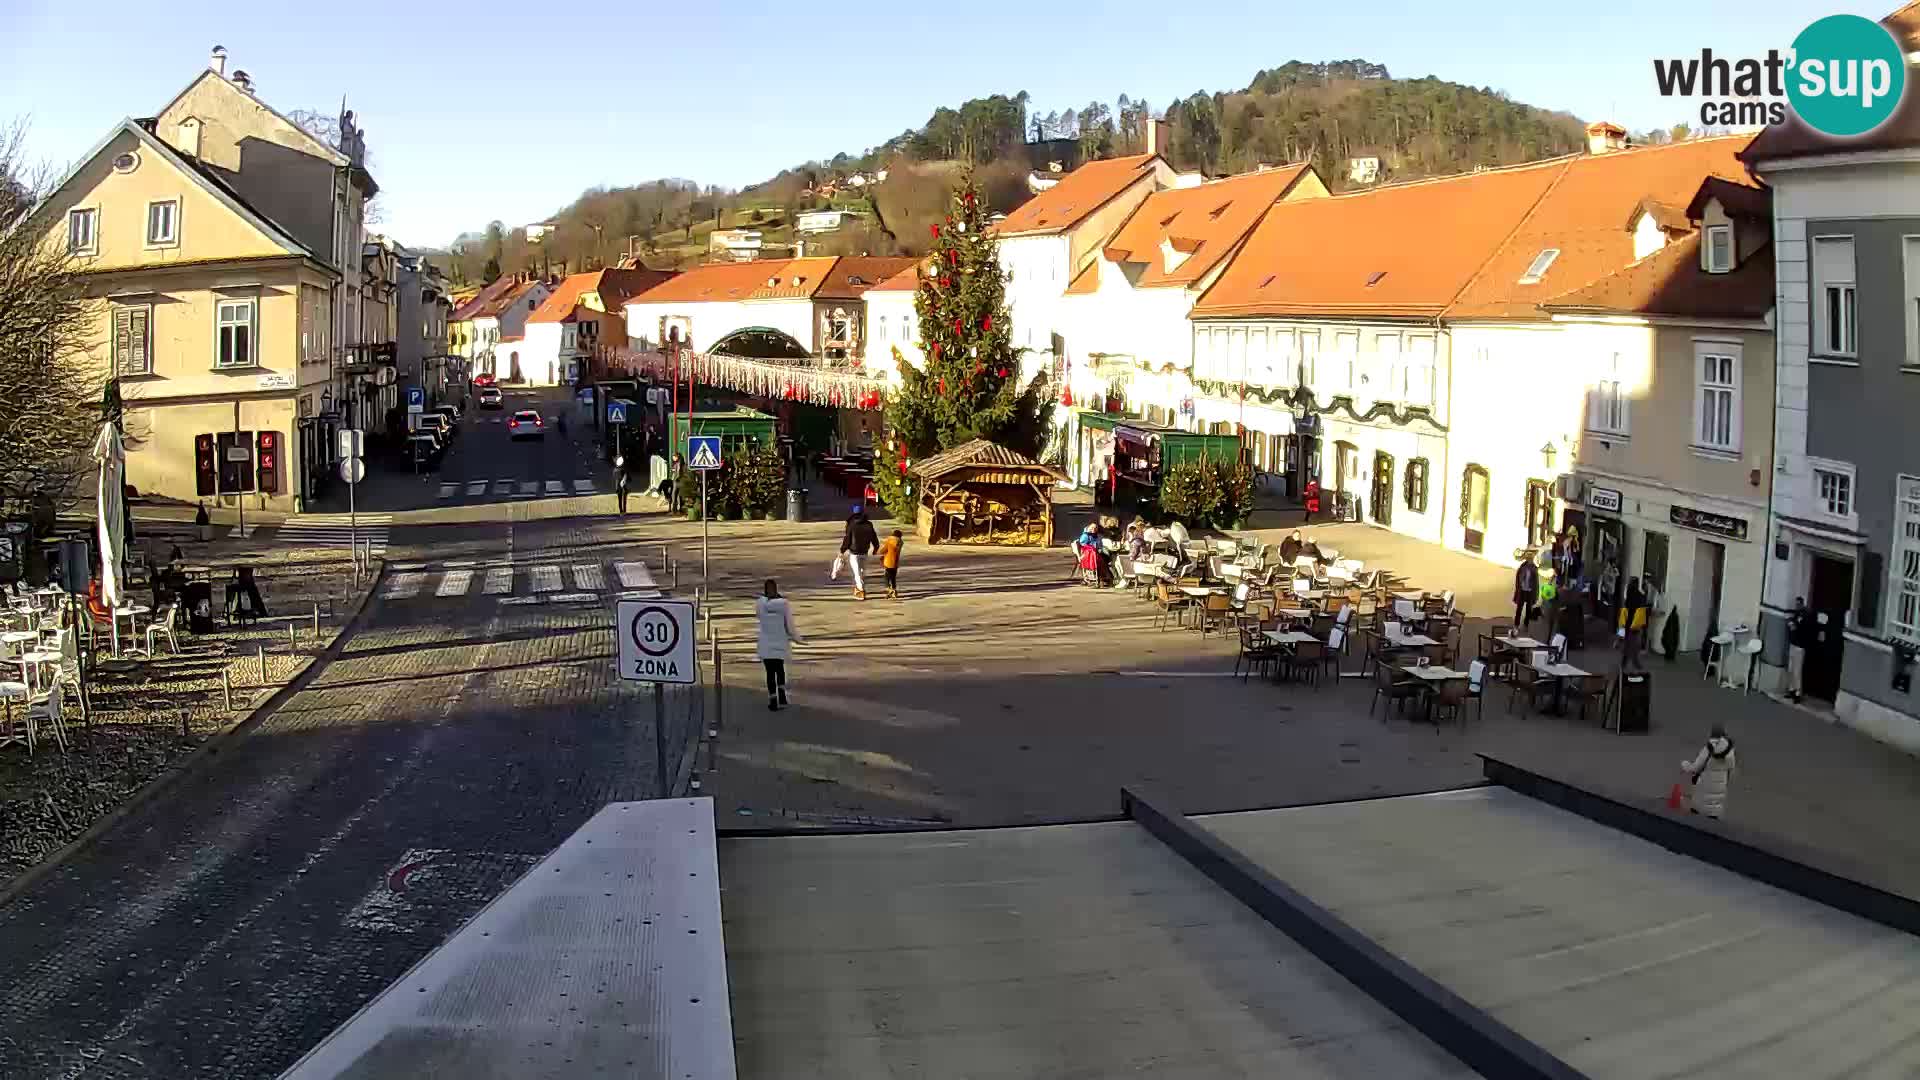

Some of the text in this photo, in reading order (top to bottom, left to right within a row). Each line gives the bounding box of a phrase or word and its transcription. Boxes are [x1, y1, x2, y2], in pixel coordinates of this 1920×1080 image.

[411, 391, 420, 402] P
[644, 622, 668, 643] 30
[634, 659, 679, 676] ZONA
